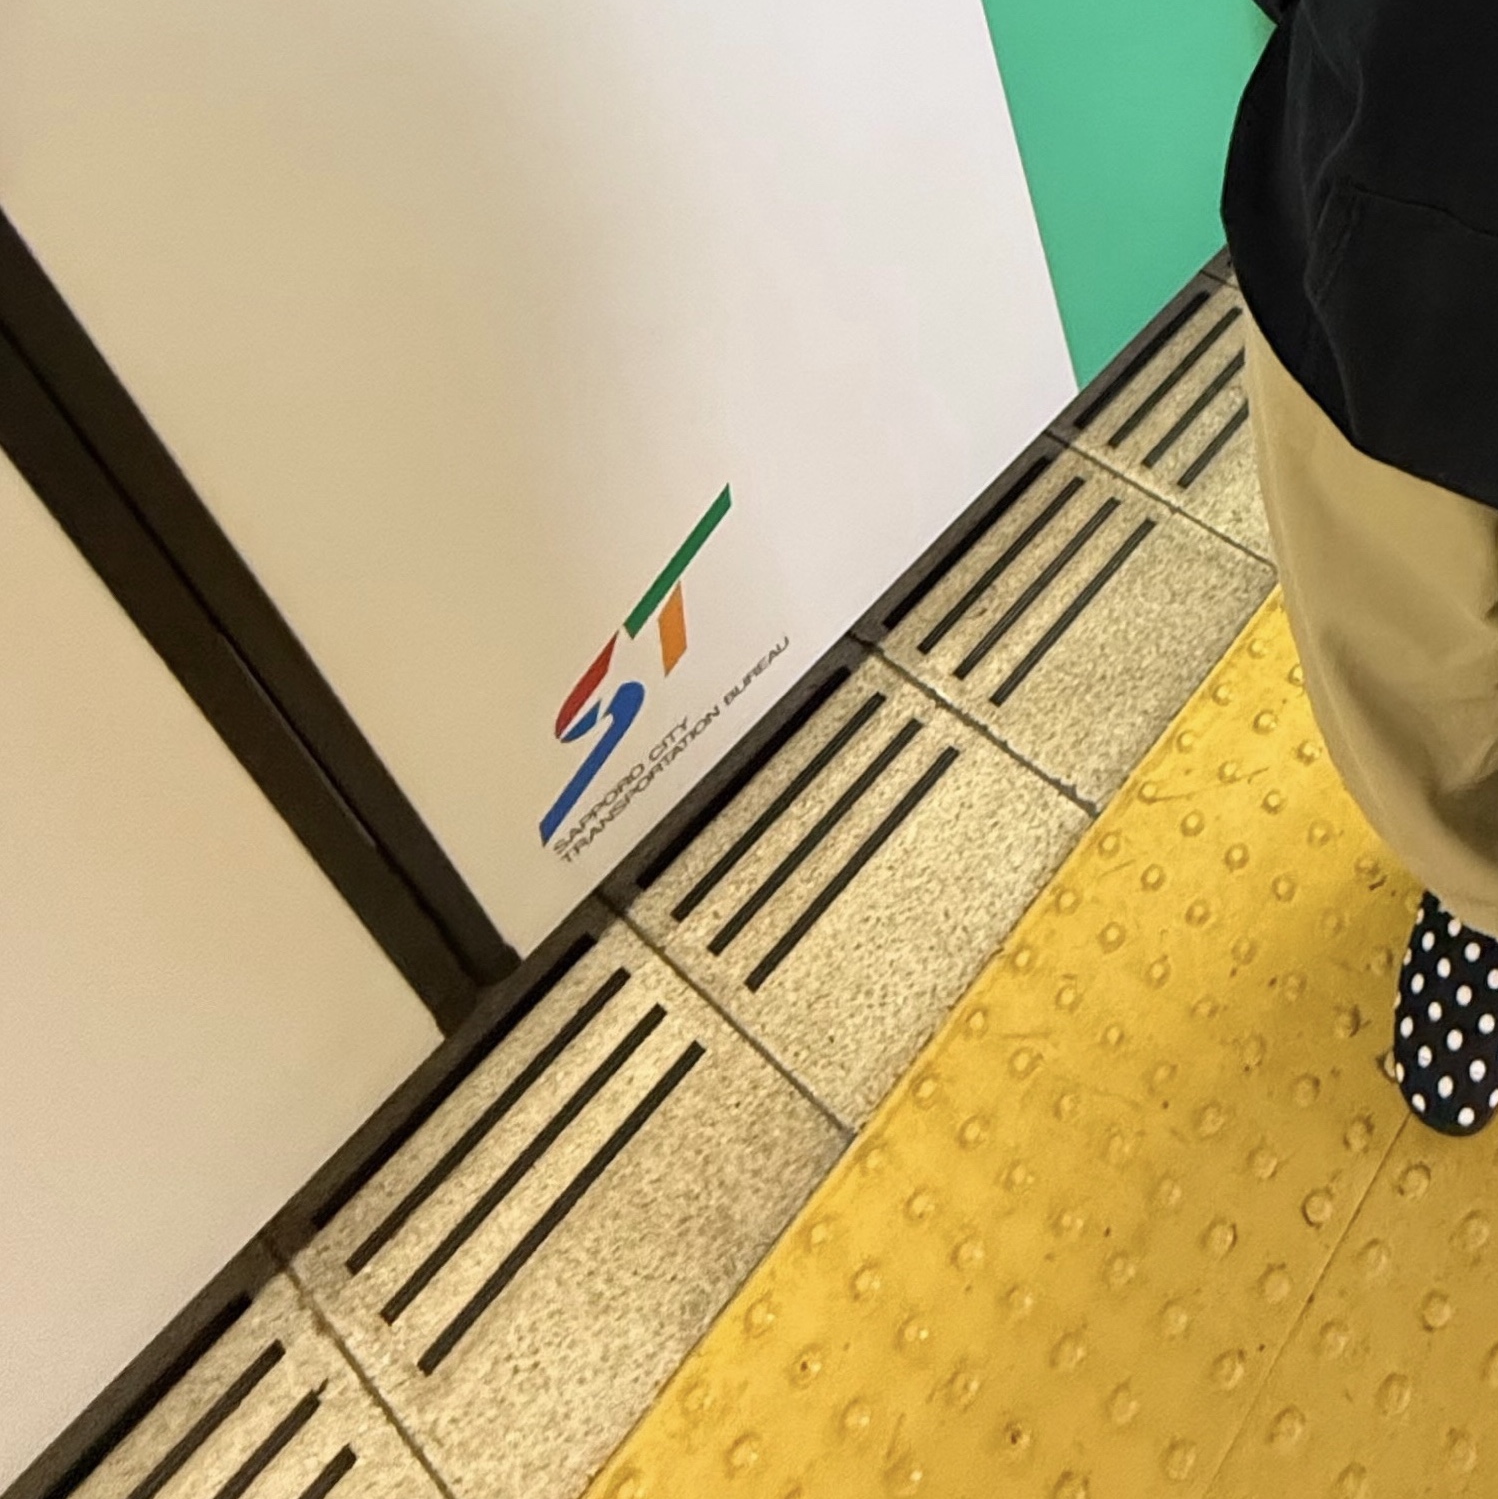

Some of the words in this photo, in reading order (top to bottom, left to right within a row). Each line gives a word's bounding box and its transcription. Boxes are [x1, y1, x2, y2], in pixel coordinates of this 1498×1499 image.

[553, 763, 645, 855] SAPPORO
[648, 715, 689, 763] CITY
[560, 705, 721, 863] TRANSPORTATION
[723, 635, 790, 706] BUREAU
